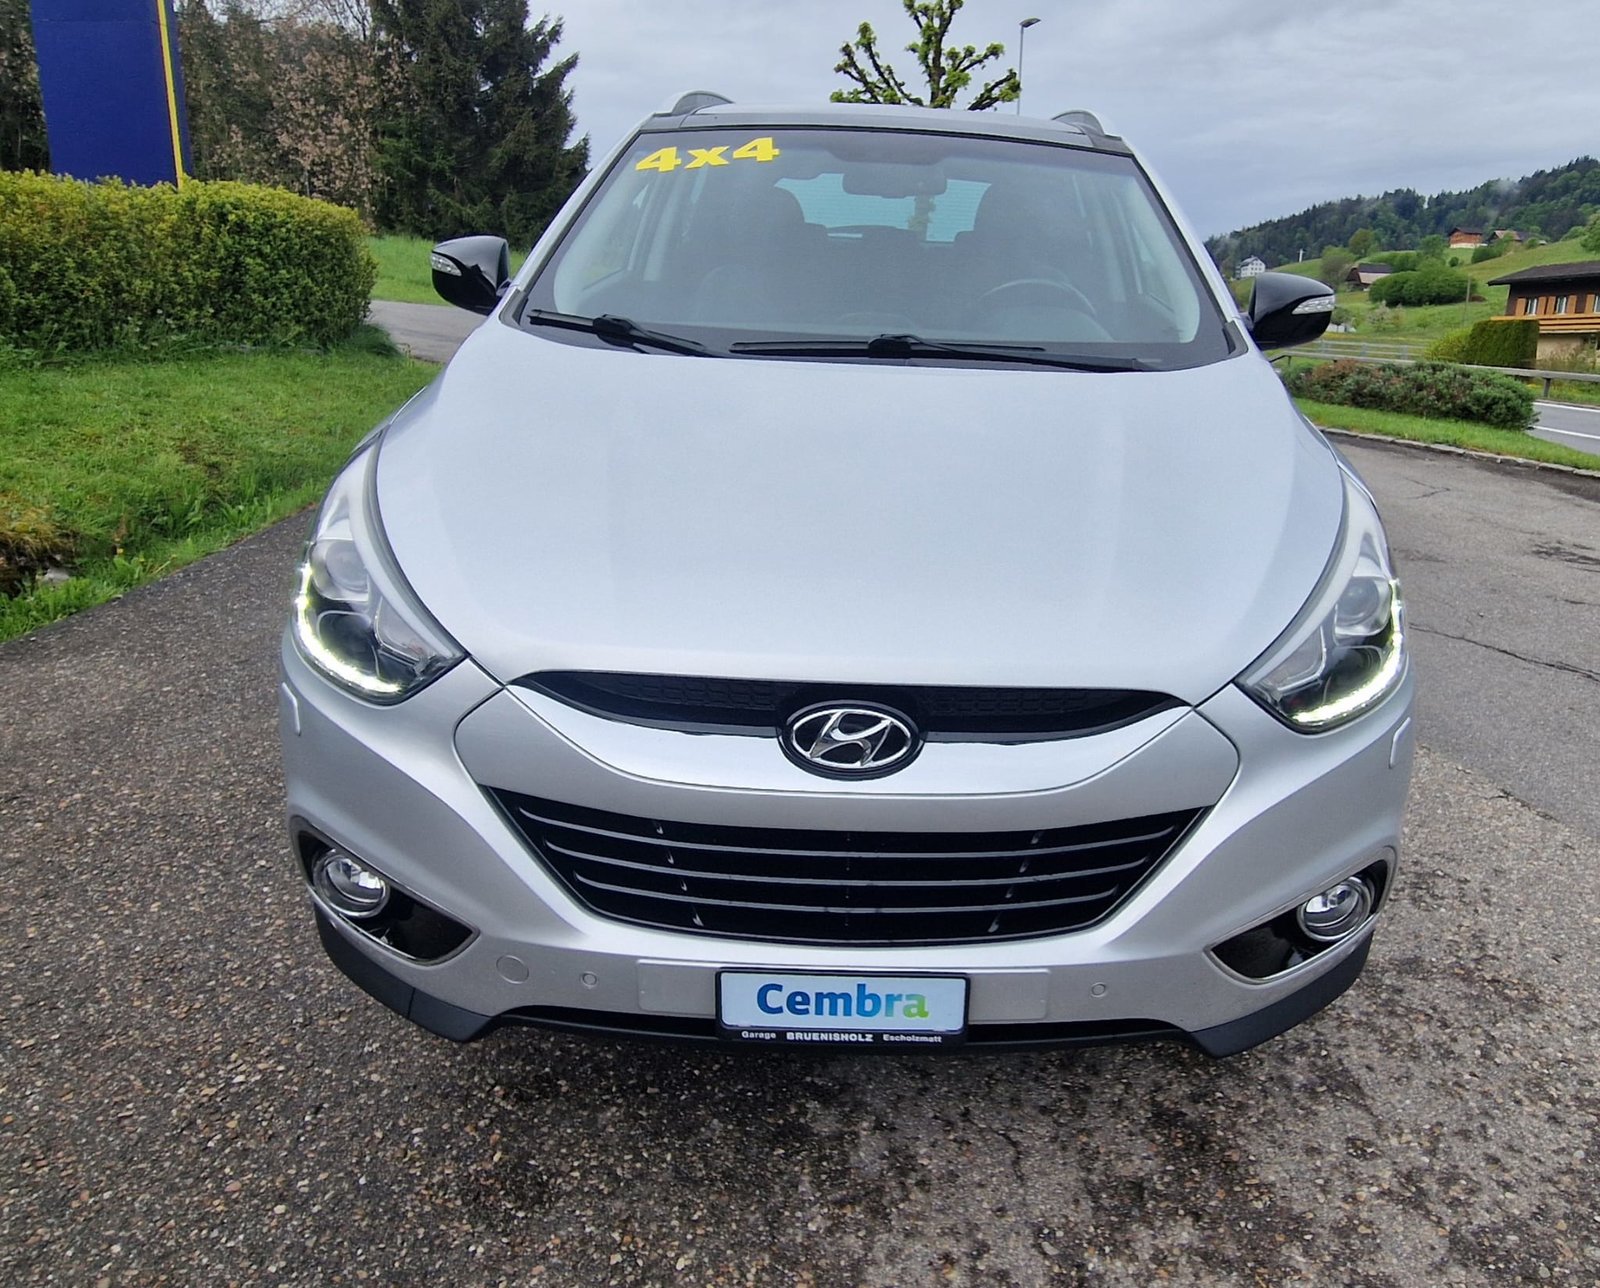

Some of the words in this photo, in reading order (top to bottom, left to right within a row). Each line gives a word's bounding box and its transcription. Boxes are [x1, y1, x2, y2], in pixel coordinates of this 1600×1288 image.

[635, 136, 780, 172] 4x4
[756, 983, 929, 1018] Cembra
[741, 1030, 777, 1040] Garage
[786, 1031, 874, 1042] BRUENISHOLZ
[883, 1033, 942, 1043] Escholzmatt
